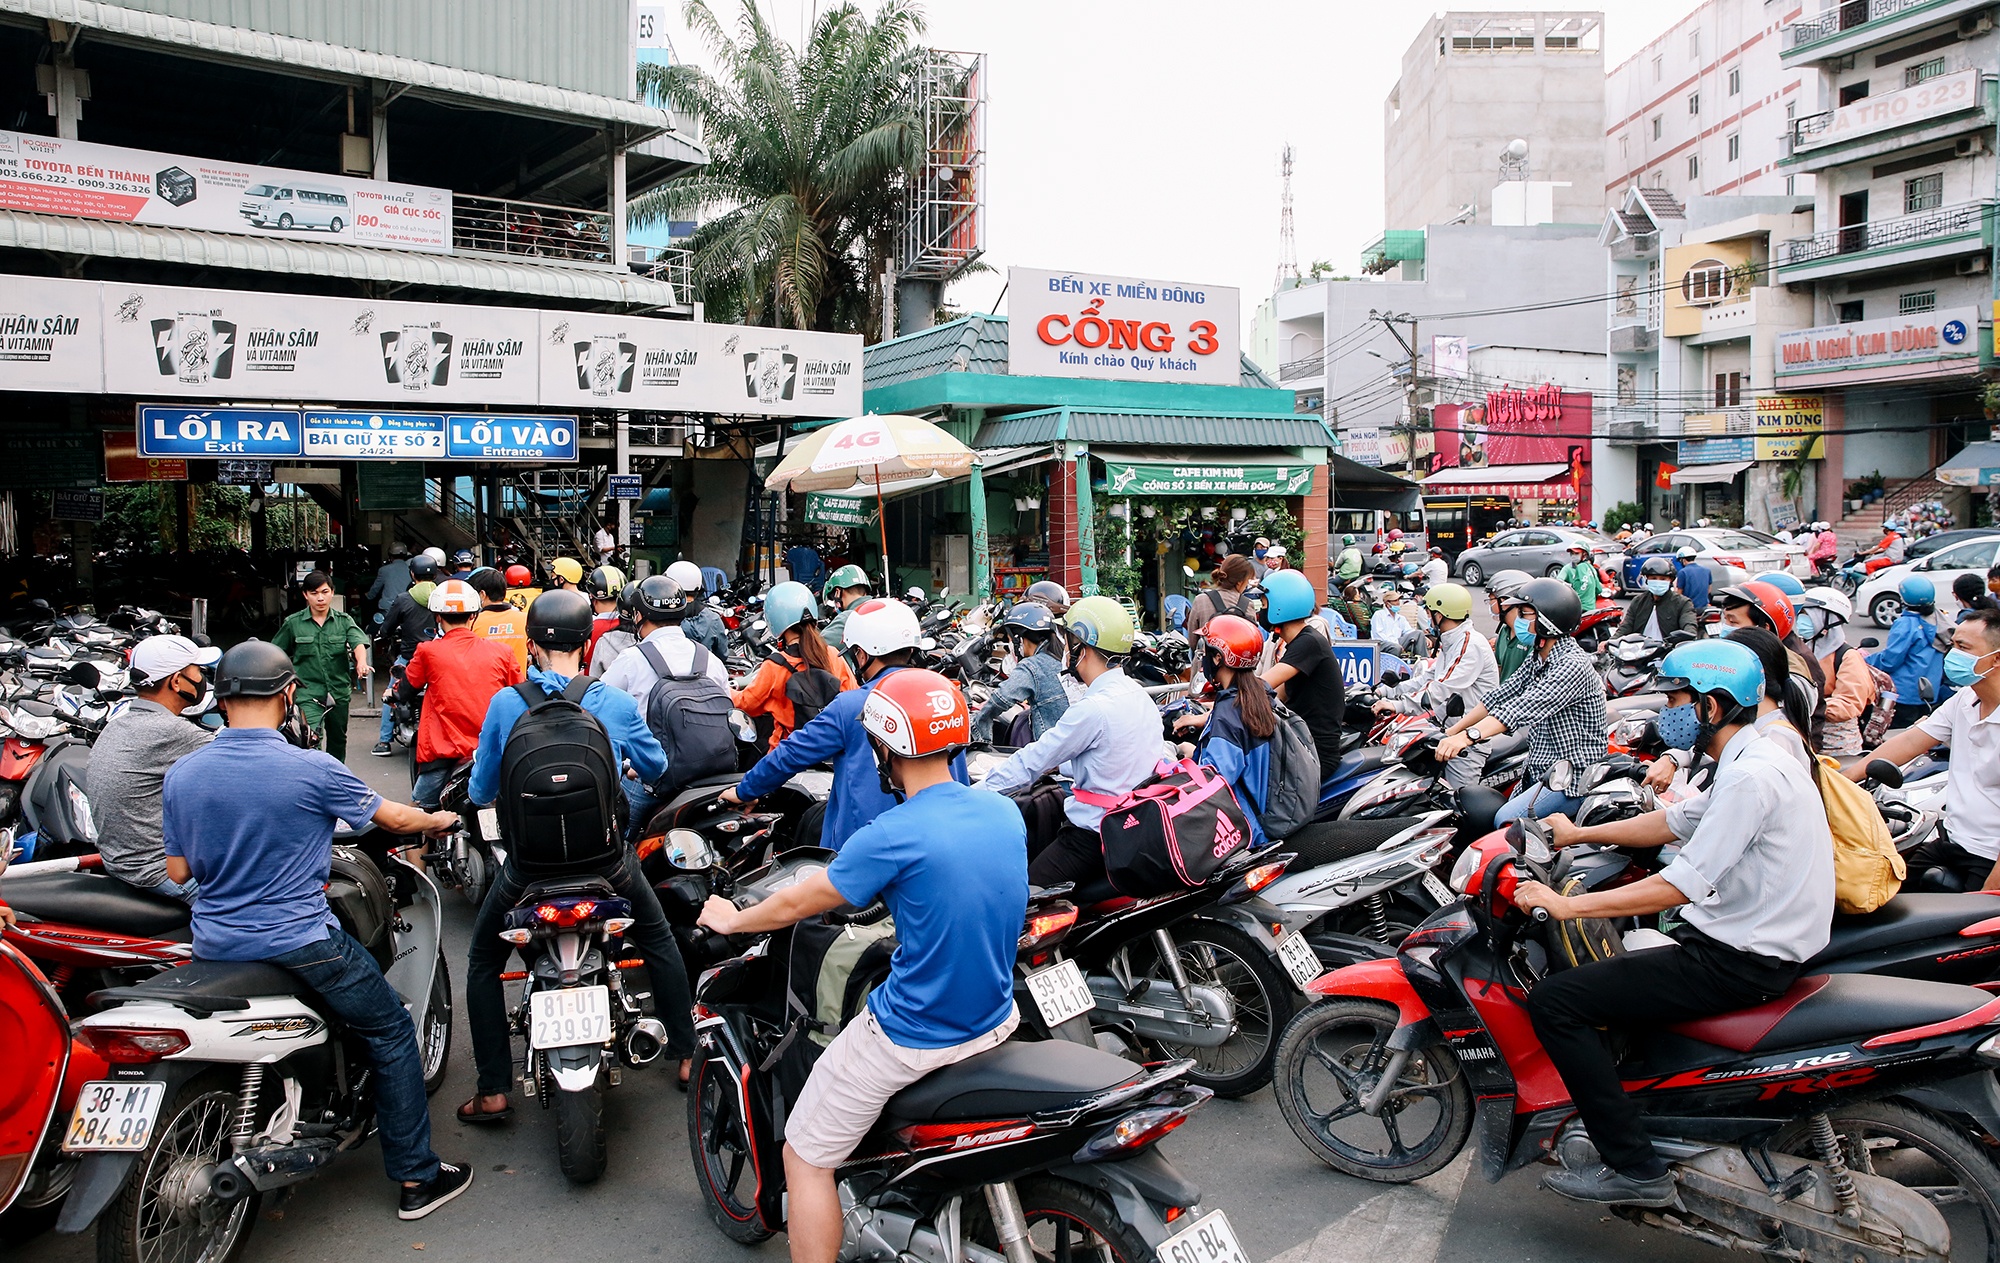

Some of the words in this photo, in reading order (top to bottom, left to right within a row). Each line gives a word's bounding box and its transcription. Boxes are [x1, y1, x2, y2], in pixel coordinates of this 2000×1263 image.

[636, 15, 654, 38] ES
[1915, 80, 1967, 109] 323
[8, 158, 18, 167] HỆ
[24, 158, 73, 174] TOYOTA
[77, 164, 104, 178] BẾN
[108, 169, 150, 184] THÀNH
[78, 178, 151, 194] 0909.326.326
[356, 191, 382, 200] TOYOTA
[384, 194, 414, 204] HIACE
[356, 214, 378, 227] 190
[384, 204, 399, 214] GIÁ
[422, 208, 440, 220] SỐC
[1048, 275, 1084, 294] BẾN
[1089, 282, 1112, 296] XE
[1117, 281, 1157, 300] MIỀN
[1162, 286, 1205, 304] ĐÔNG
[42, 314, 80, 336] SÂM
[1037, 298, 1176, 353] CỔNG
[1188, 320, 1219, 355] 3
[8, 338, 54, 351] VITAMIN
[247, 328, 285, 347] NHÂN
[288, 328, 319, 347] SÂM
[462, 338, 494, 356] NHÂN
[496, 338, 523, 356] SÂM
[1782, 336, 1814, 364] NHÀ
[1816, 329, 1853, 360] NGHỈ
[1856, 332, 1887, 356] KIM
[1892, 324, 1939, 352] DŨNG
[246, 349, 257, 362] VÀ
[260, 350, 298, 362] VITAMIN
[460, 358, 470, 370] VÀ
[472, 358, 504, 370] VITAMIN
[644, 348, 673, 366] NHÂN
[674, 348, 698, 366] SÂM
[1060, 351, 1088, 365] Kính
[1094, 354, 1125, 368] chào
[1130, 356, 1154, 371] Quý
[1160, 357, 1197, 371] khách
[642, 366, 652, 378] VÀ
[652, 367, 682, 378] VITAMIN
[804, 360, 829, 376] NHÂN
[830, 360, 851, 376] SÂM
[812, 377, 836, 387] VITAMIN
[1487, 383, 1522, 424] NÓN
[154, 412, 222, 440] LỐI
[238, 420, 291, 441] RA
[1757, 415, 1782, 426] KIM
[1784, 412, 1822, 426] DŨNG
[309, 431, 338, 445] BÃI
[344, 432, 372, 446] GIỮ
[378, 435, 398, 446] XE
[404, 432, 426, 446] SỐ
[432, 436, 440, 446] 2
[453, 419, 502, 444] LỐI
[512, 422, 571, 446] VÀO
[834, 431, 882, 450] 4G
[1350, 430, 1362, 440] NHÀ
[204, 440, 245, 453] Exit
[482, 446, 543, 456] Entrance
[1416, 437, 1429, 450] RỌ
[1766, 440, 1796, 448] PHỤC
[1173, 467, 1200, 478] CAFE
[1202, 468, 1221, 478] KIM
[1222, 466, 1244, 480] HUỆ
[1172, 478, 1186, 490] SỐ
[1186, 482, 1192, 490] 3
[1194, 480, 1213, 490] BẾN
[1214, 482, 1228, 490] XE
[57, 492, 71, 500] BÃI
[73, 493, 86, 502] GIỮ
[823, 498, 838, 508] CAFE
[662, 598, 681, 606] IDIGO
[1775, 599, 1792, 624] FILA
[1338, 652, 1372, 684] VÀO
[1122, 820, 1140, 830] adidas
[1213, 830, 1242, 859] adidas
[1291, 953, 1321, 986] 062.01
[1034, 966, 1074, 998] 59-B1
[544, 990, 597, 1018] 81-U1
[1041, 986, 1091, 1022] 514.10
[537, 1015, 605, 1045] 239.97
[1456, 1046, 1496, 1061] YAMAHA
[1702, 1062, 1790, 1081] SIRIUS
[1791, 1052, 1852, 1070] RC
[1758, 1067, 1880, 1101] RC
[86, 1086, 151, 1114] 38-M1
[70, 1118, 148, 1146] 284.98
[950, 1125, 1033, 1150] Wave
[1172, 1223, 1228, 1263] 60-B4
